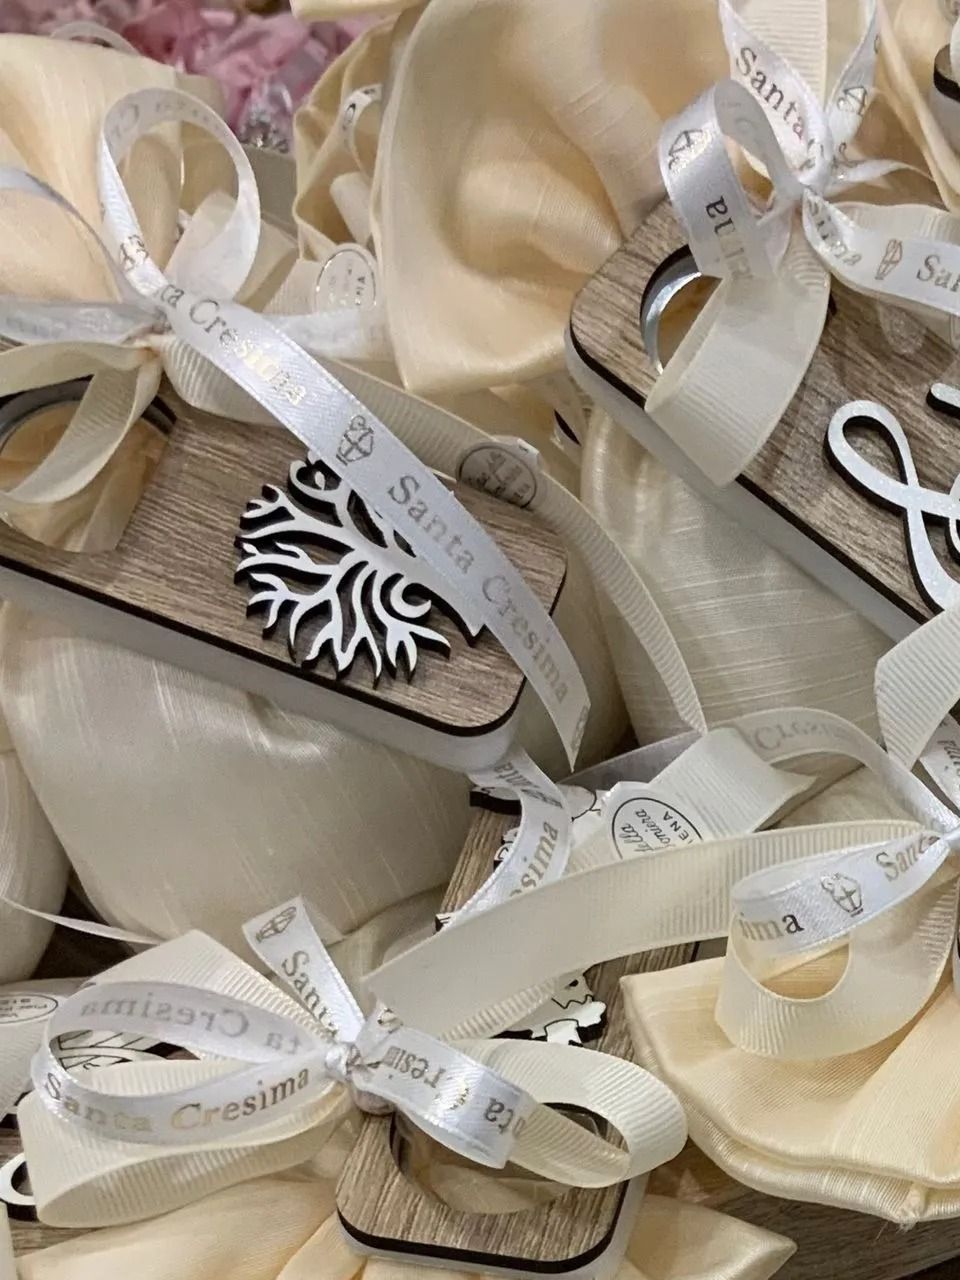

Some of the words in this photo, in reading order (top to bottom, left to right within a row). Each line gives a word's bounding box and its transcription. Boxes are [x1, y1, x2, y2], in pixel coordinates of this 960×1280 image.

[735, 47, 807, 139] Santa
[387, 474, 476, 574] Santa
[481, 574, 570, 702] Cresima
[44, 1072, 154, 1133] Santa
[170, 1067, 310, 1132] Cresima
